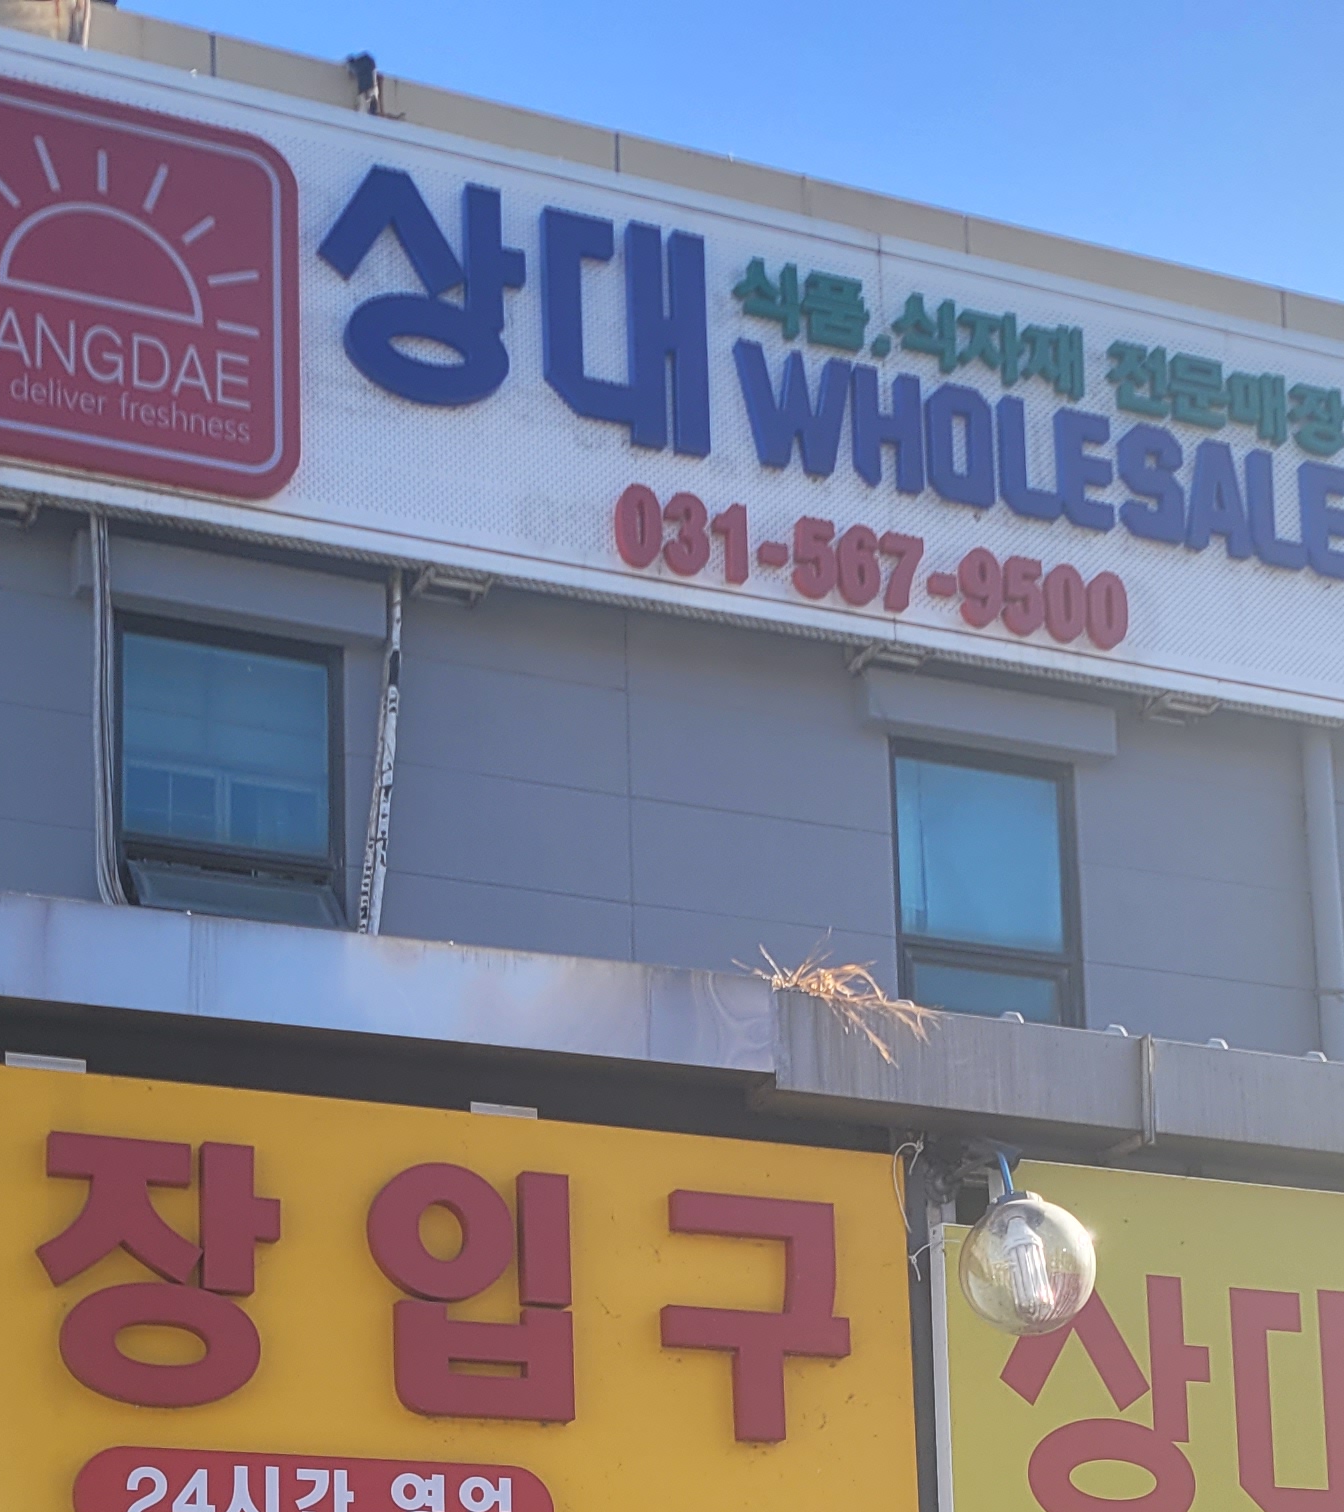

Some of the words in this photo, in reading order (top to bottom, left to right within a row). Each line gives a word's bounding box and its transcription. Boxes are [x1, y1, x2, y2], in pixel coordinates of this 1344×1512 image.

[317, 165, 711, 458] 상대
[10, 372, 106, 415] deliver
[119, 391, 253, 445] freshness
[614, 483, 1129, 651] 031-567-9500
